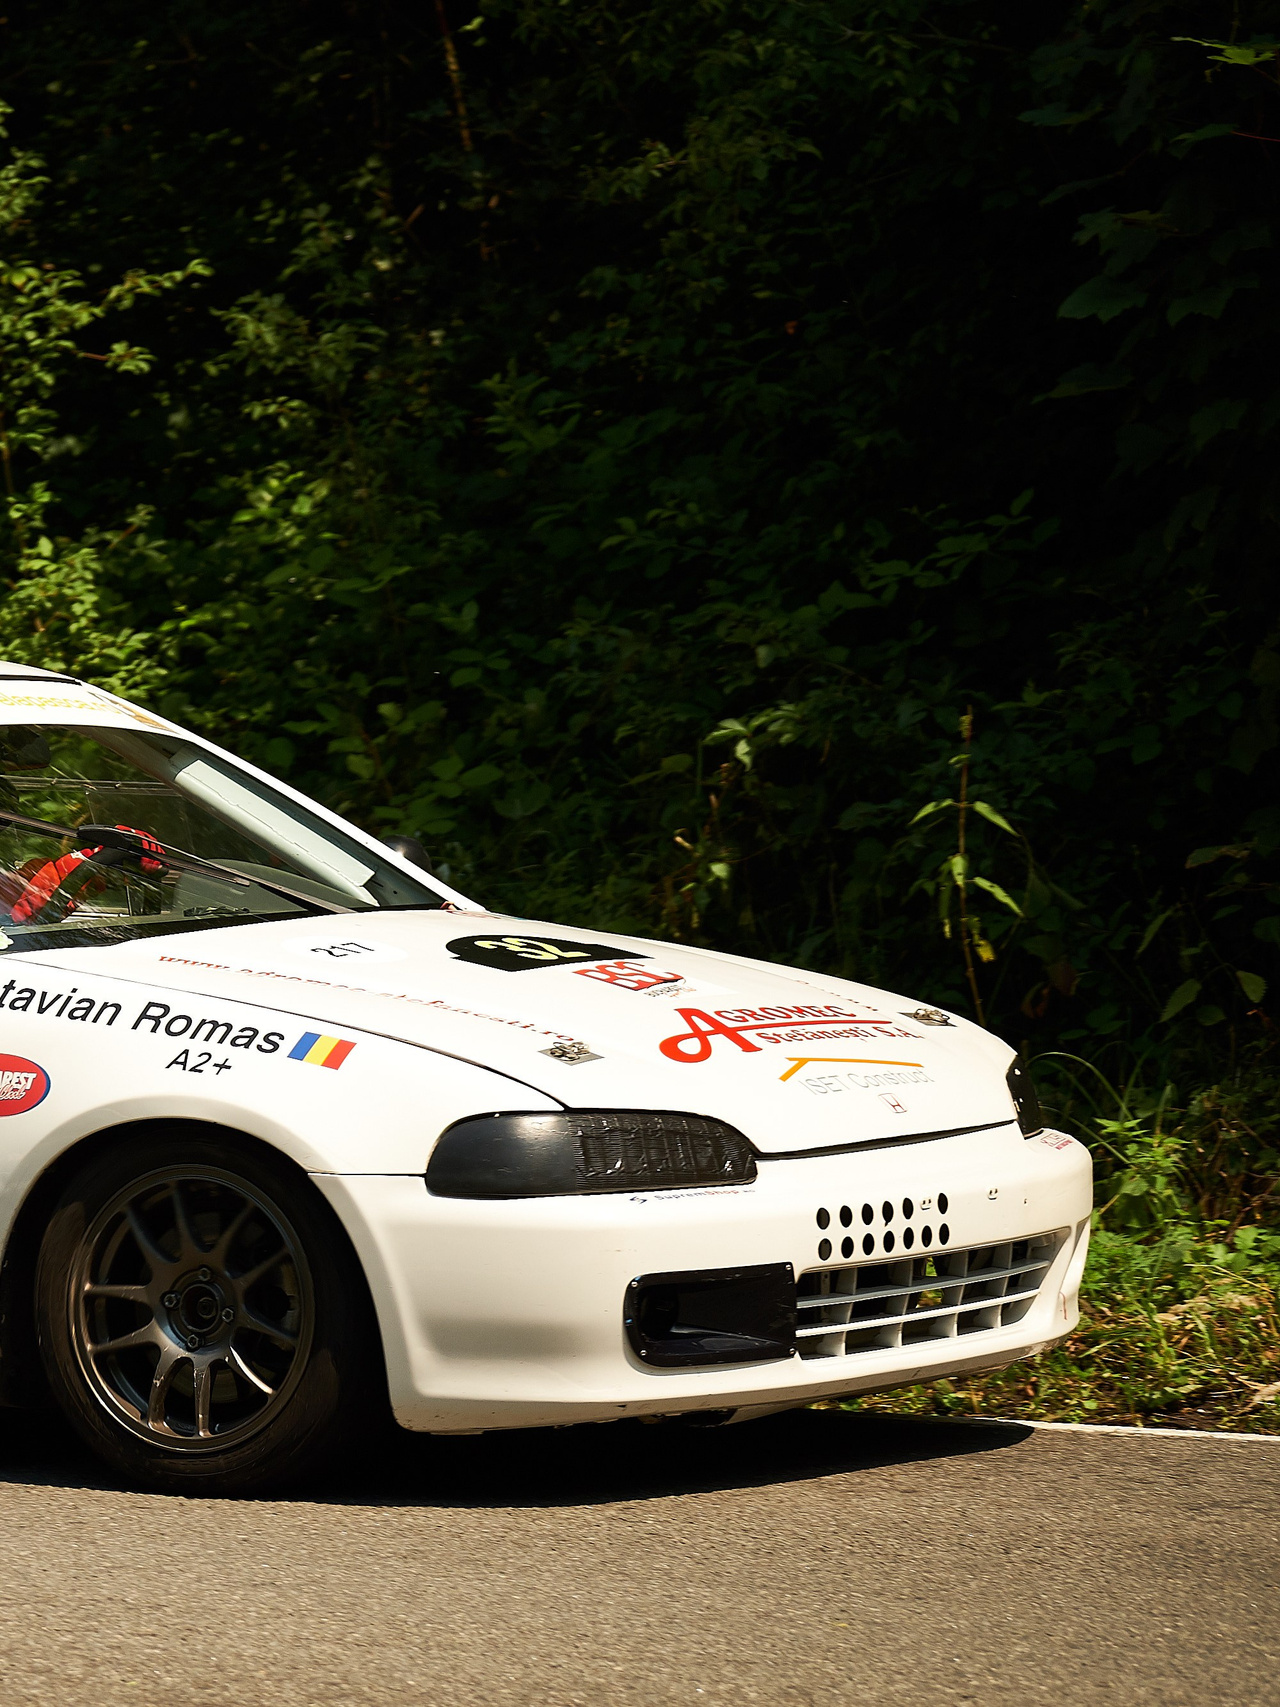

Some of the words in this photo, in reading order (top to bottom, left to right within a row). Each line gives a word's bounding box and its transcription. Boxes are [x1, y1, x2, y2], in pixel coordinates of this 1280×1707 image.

[474, 937, 592, 961] 32
[131, 1001, 286, 1055] Romas
[659, 1006, 856, 1063] AGROMEC
[165, 1049, 232, 1077] A2+
[799, 1074, 850, 1096] ISET
[848, 1068, 935, 1089] Construct
